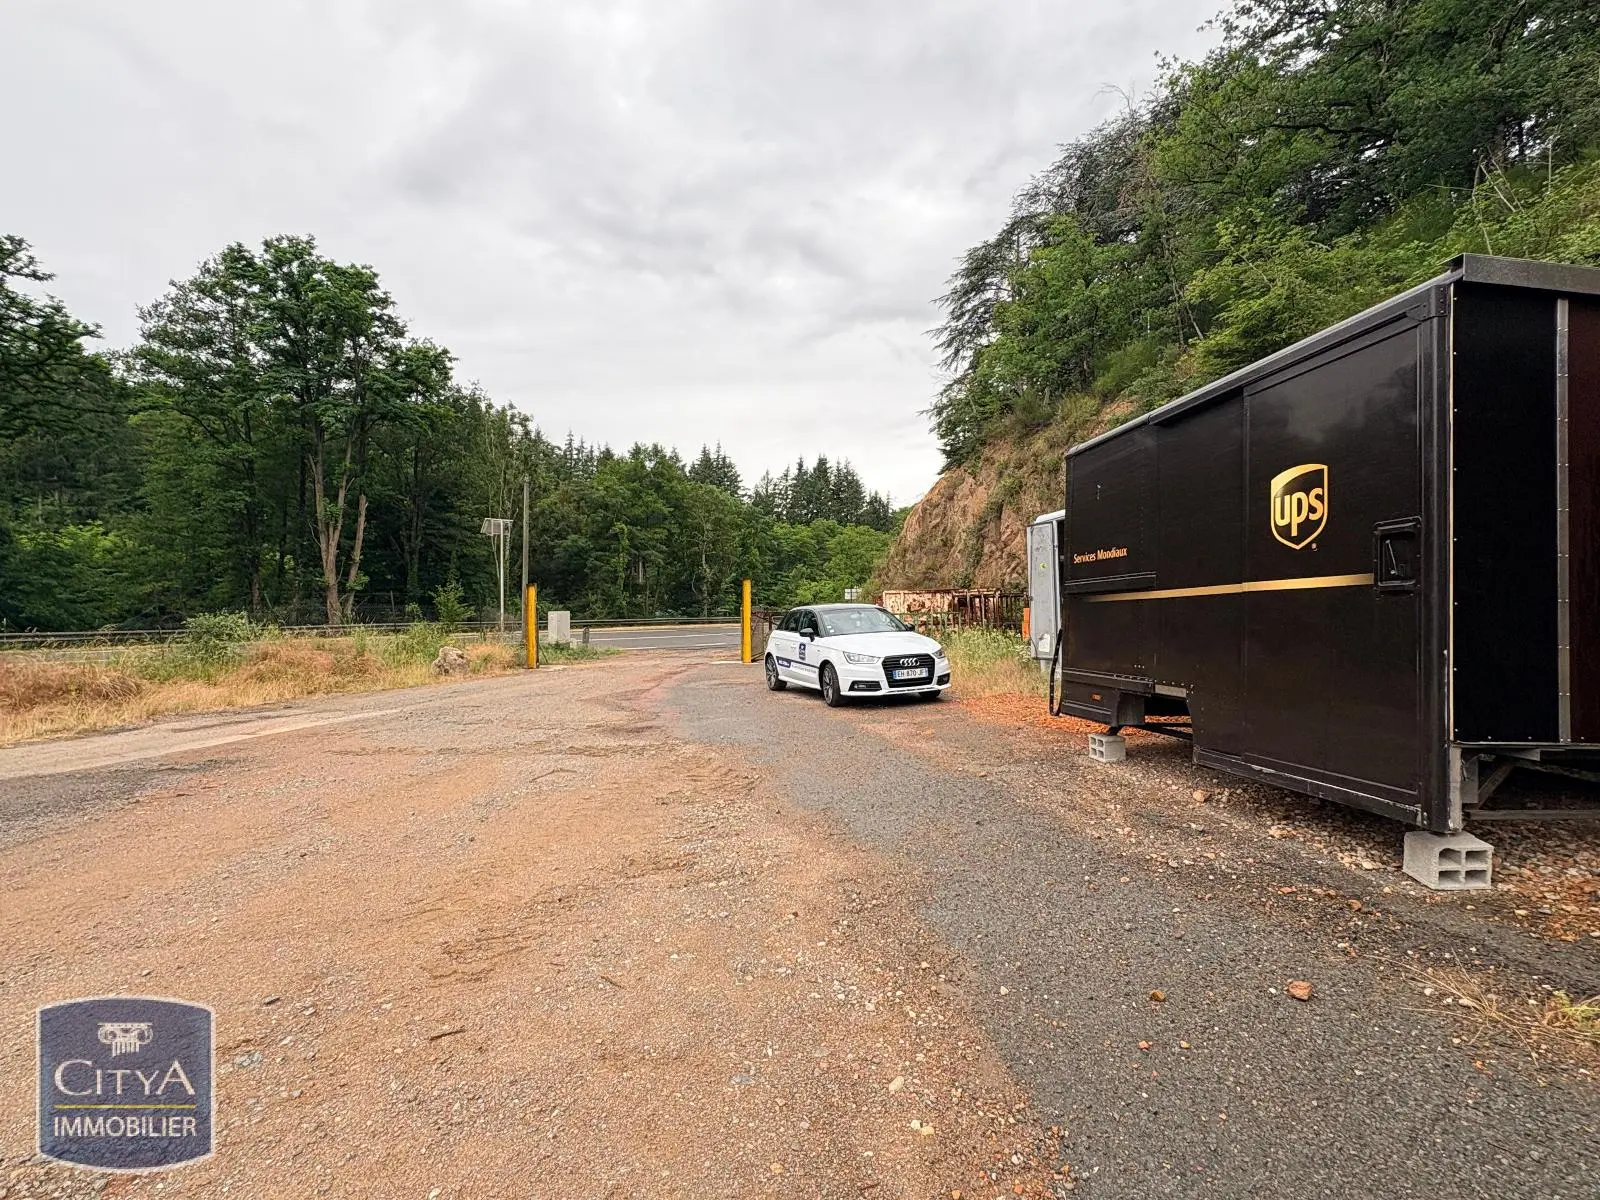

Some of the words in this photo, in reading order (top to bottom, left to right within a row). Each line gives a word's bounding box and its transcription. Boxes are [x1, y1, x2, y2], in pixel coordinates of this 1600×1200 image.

[1275, 487, 1324, 537] ups
[1073, 552, 1097, 564] Services
[1097, 547, 1128, 561] Mondiaux
